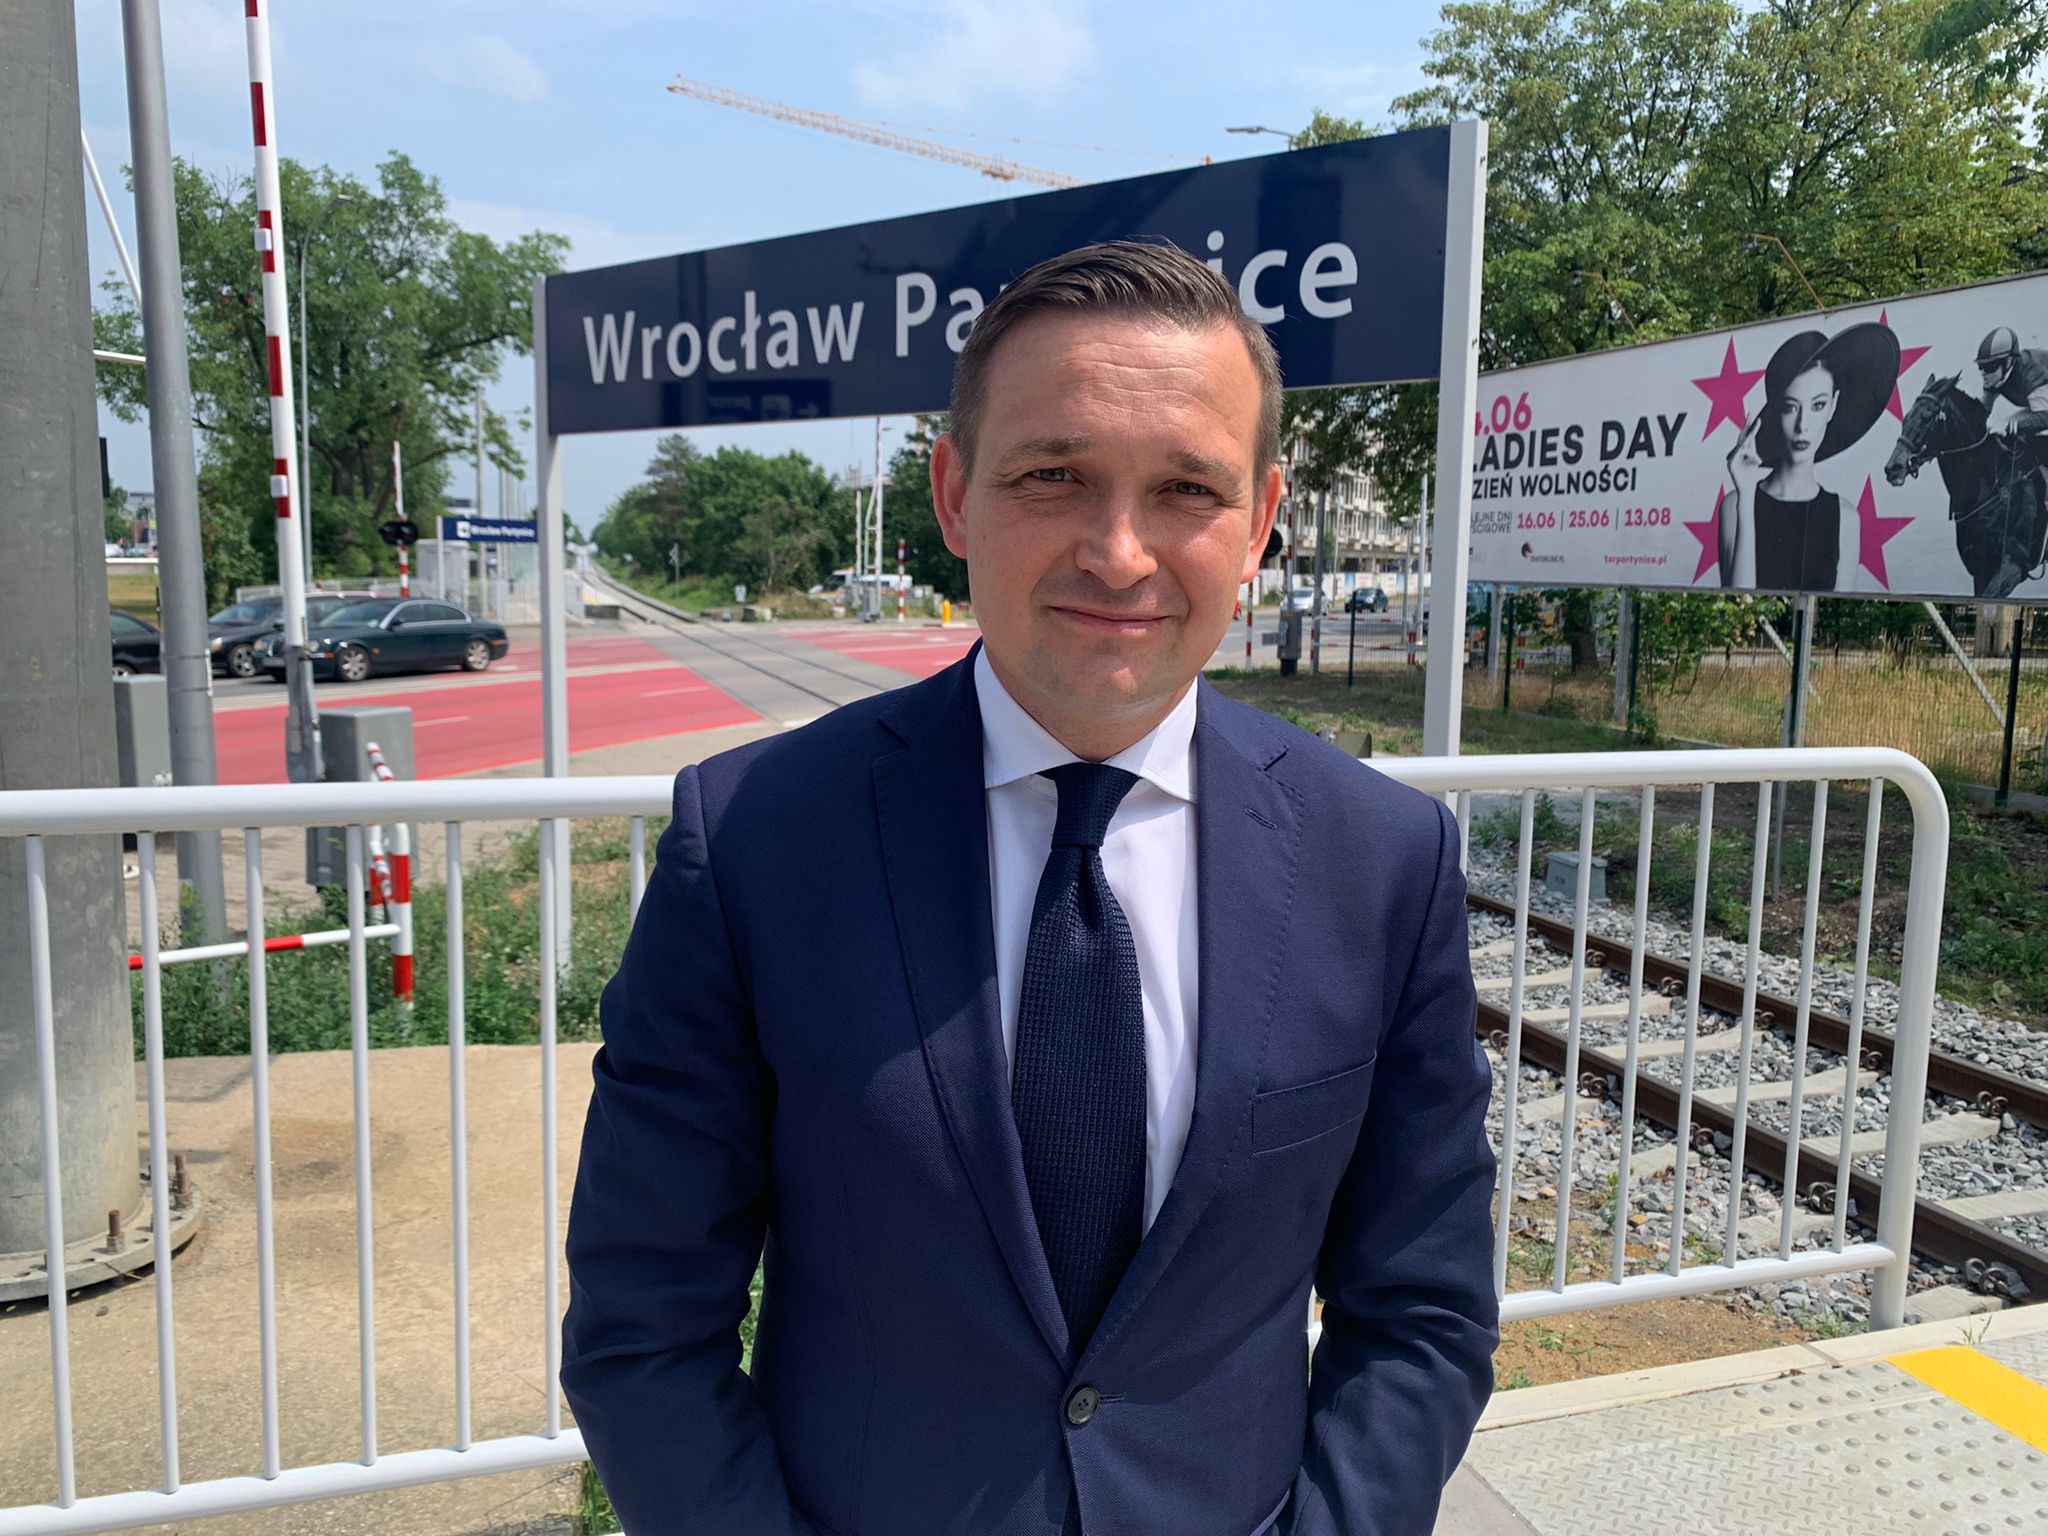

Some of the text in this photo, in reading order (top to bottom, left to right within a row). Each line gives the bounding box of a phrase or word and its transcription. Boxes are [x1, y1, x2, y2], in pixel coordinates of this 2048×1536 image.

[582, 230, 1360, 384] Wrocław Paice
[1600, 412, 1688, 461] DAY
[1472, 463, 1637, 500] ZIEŃ WOLNOŚCI
[1517, 506, 1671, 530] 16.06 25.06 13.08
